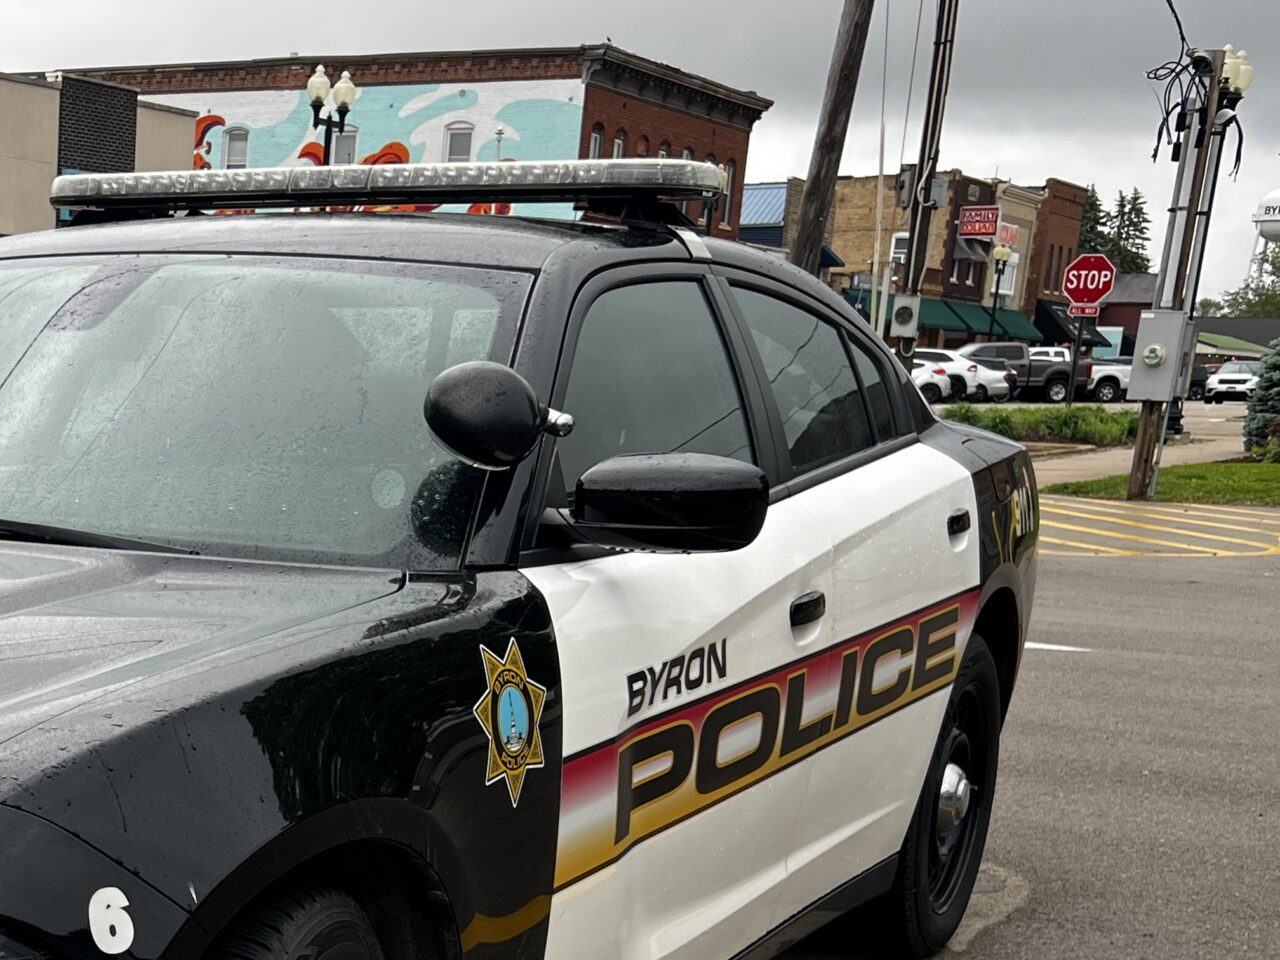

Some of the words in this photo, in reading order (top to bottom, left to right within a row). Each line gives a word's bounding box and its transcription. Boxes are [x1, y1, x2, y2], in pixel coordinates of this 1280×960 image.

[962, 210, 998, 221] FAMILY
[1066, 269, 1112, 289] STOP
[493, 670, 525, 696] BYRON
[626, 638, 728, 718] BYRON
[614, 602, 960, 846] POLICE
[501, 744, 530, 771] POLICE
[88, 886, 136, 955] 6
